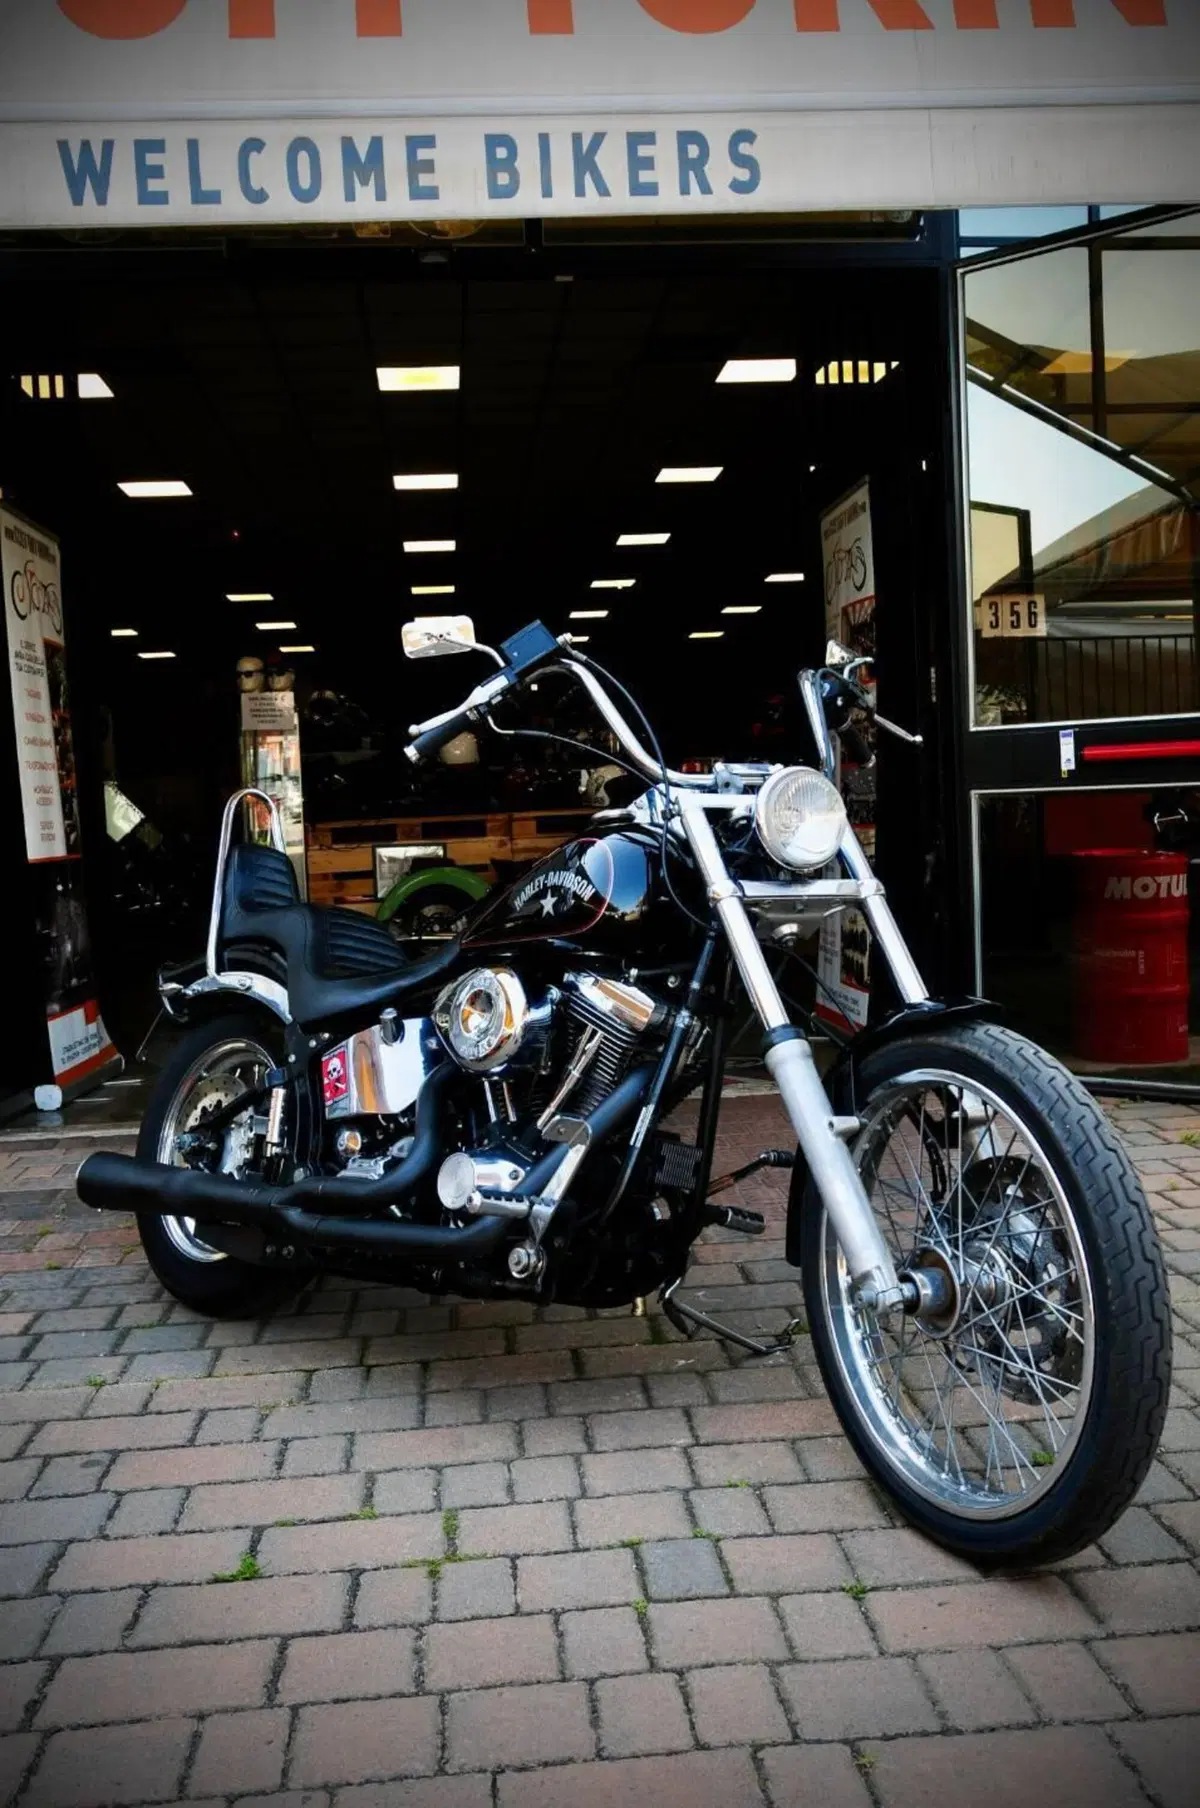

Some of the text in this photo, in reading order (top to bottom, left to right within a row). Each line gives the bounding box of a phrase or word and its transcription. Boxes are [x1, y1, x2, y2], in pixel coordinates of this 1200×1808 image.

[56, 129, 762, 206] WELCOME BIKERS
[988, 600, 1038, 630] 356
[514, 871, 596, 911] HARLEY-DAVIDSON
